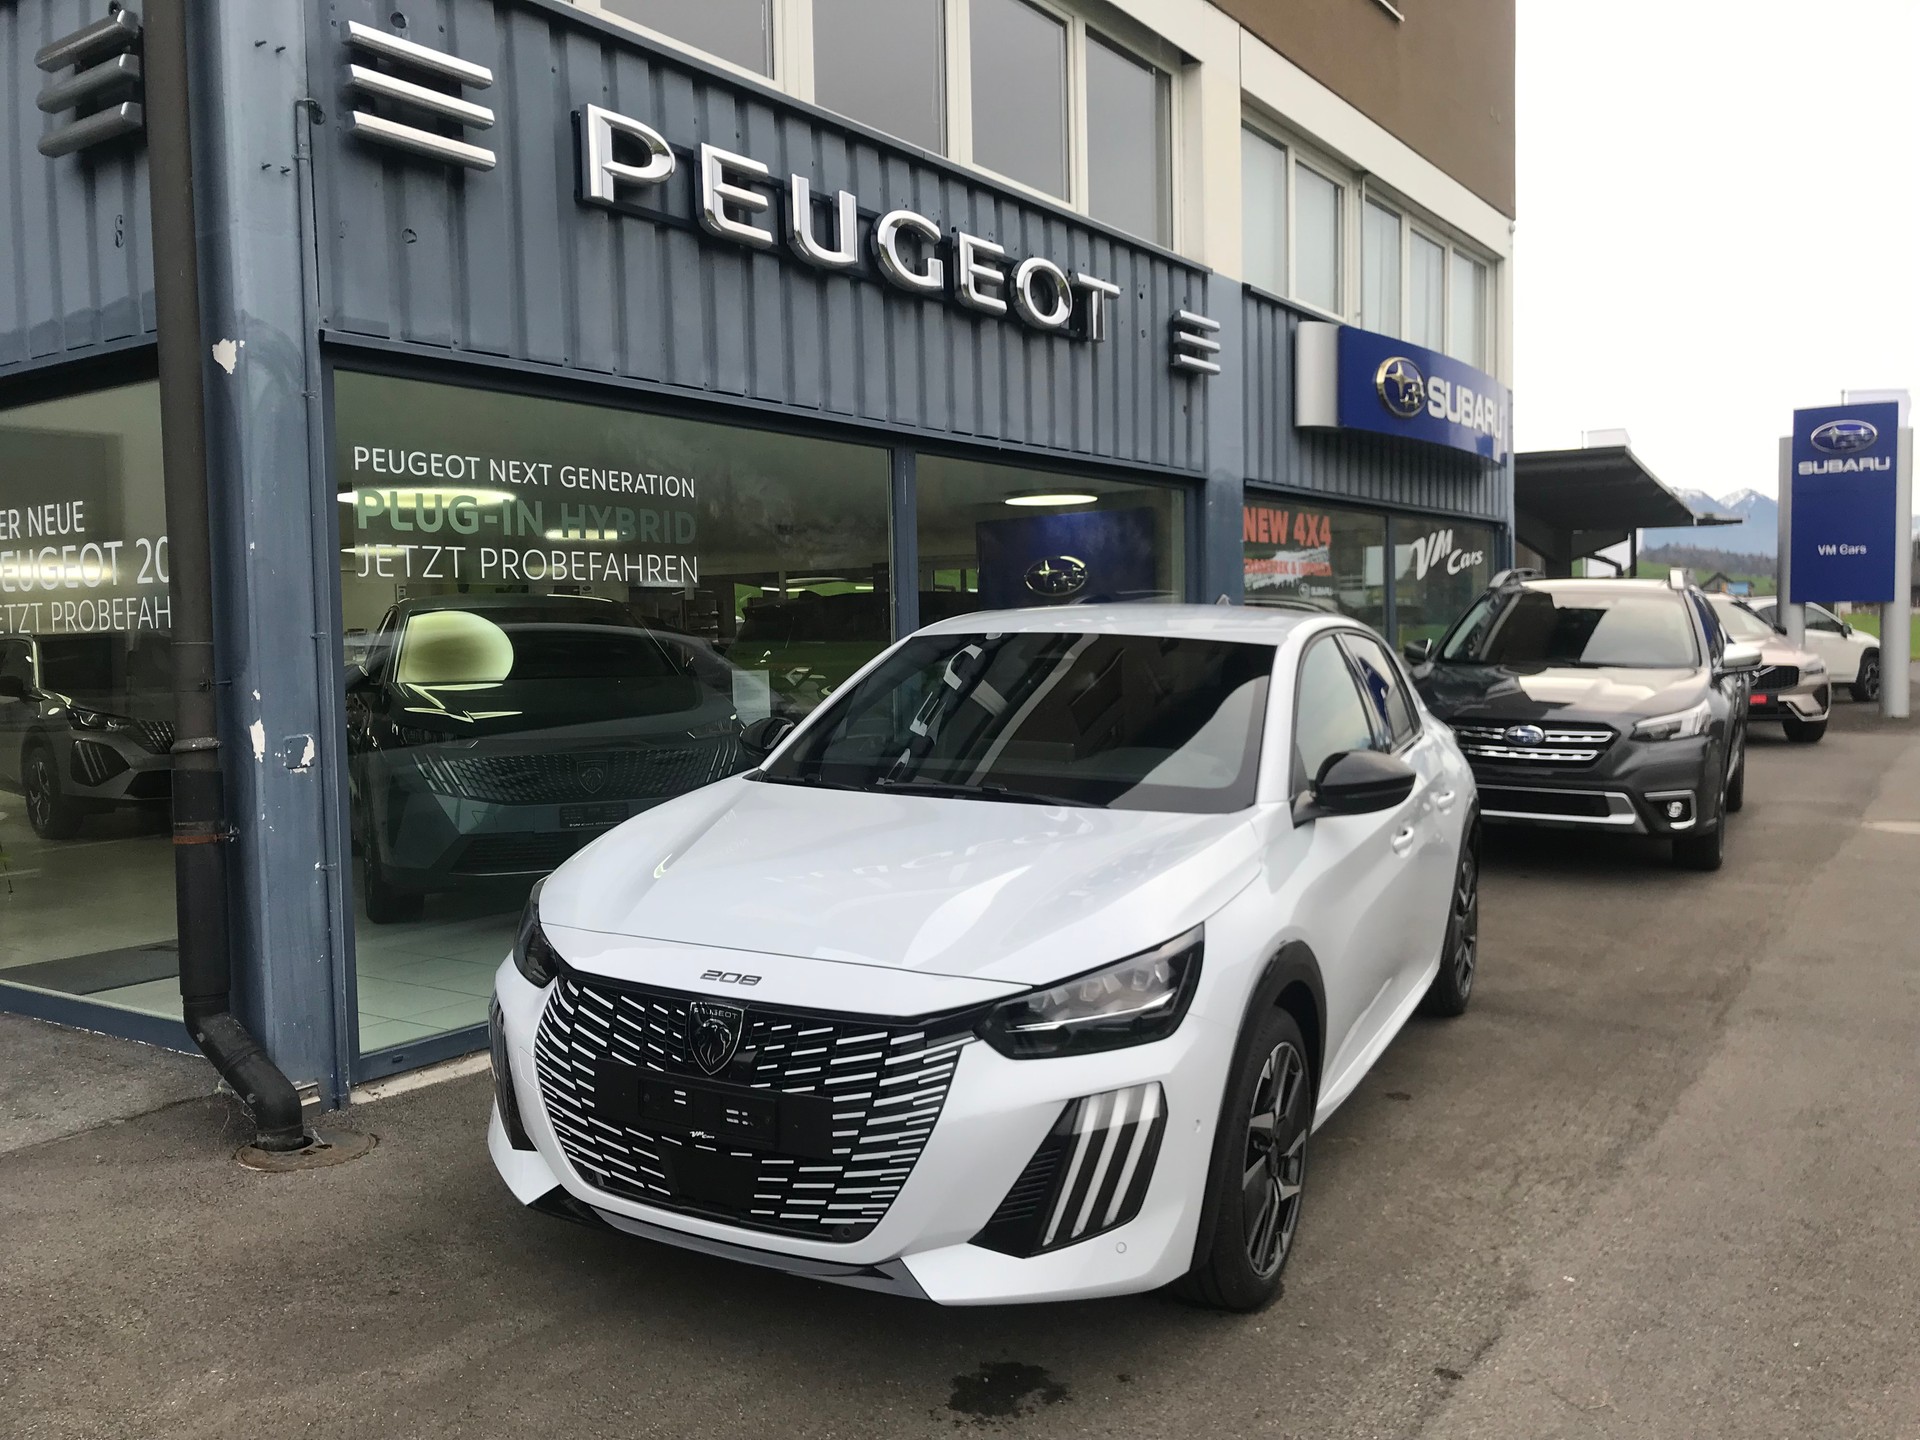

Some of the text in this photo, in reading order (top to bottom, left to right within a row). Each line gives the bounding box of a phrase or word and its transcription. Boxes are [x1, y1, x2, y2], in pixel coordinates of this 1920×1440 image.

[579, 104, 1120, 342] PEUGEOT
[1427, 376, 1503, 440] SUBARU
[354, 446, 695, 498] PEUGEOT NEXT GENERATION
[1798, 456, 1891, 475] SUBARU
[28, 501, 85, 538] NEUE
[357, 489, 697, 545] PLUG-IN HYBRID
[1243, 506, 1332, 549] NEW 4X4
[357, 543, 698, 583] JETZT PROBEFAHREN
[1410, 528, 1484, 581] VM Cars
[1818, 544, 1867, 556] VM Cars
[51, 596, 172, 633] PROBEFAH
[700, 969, 763, 986] 208
